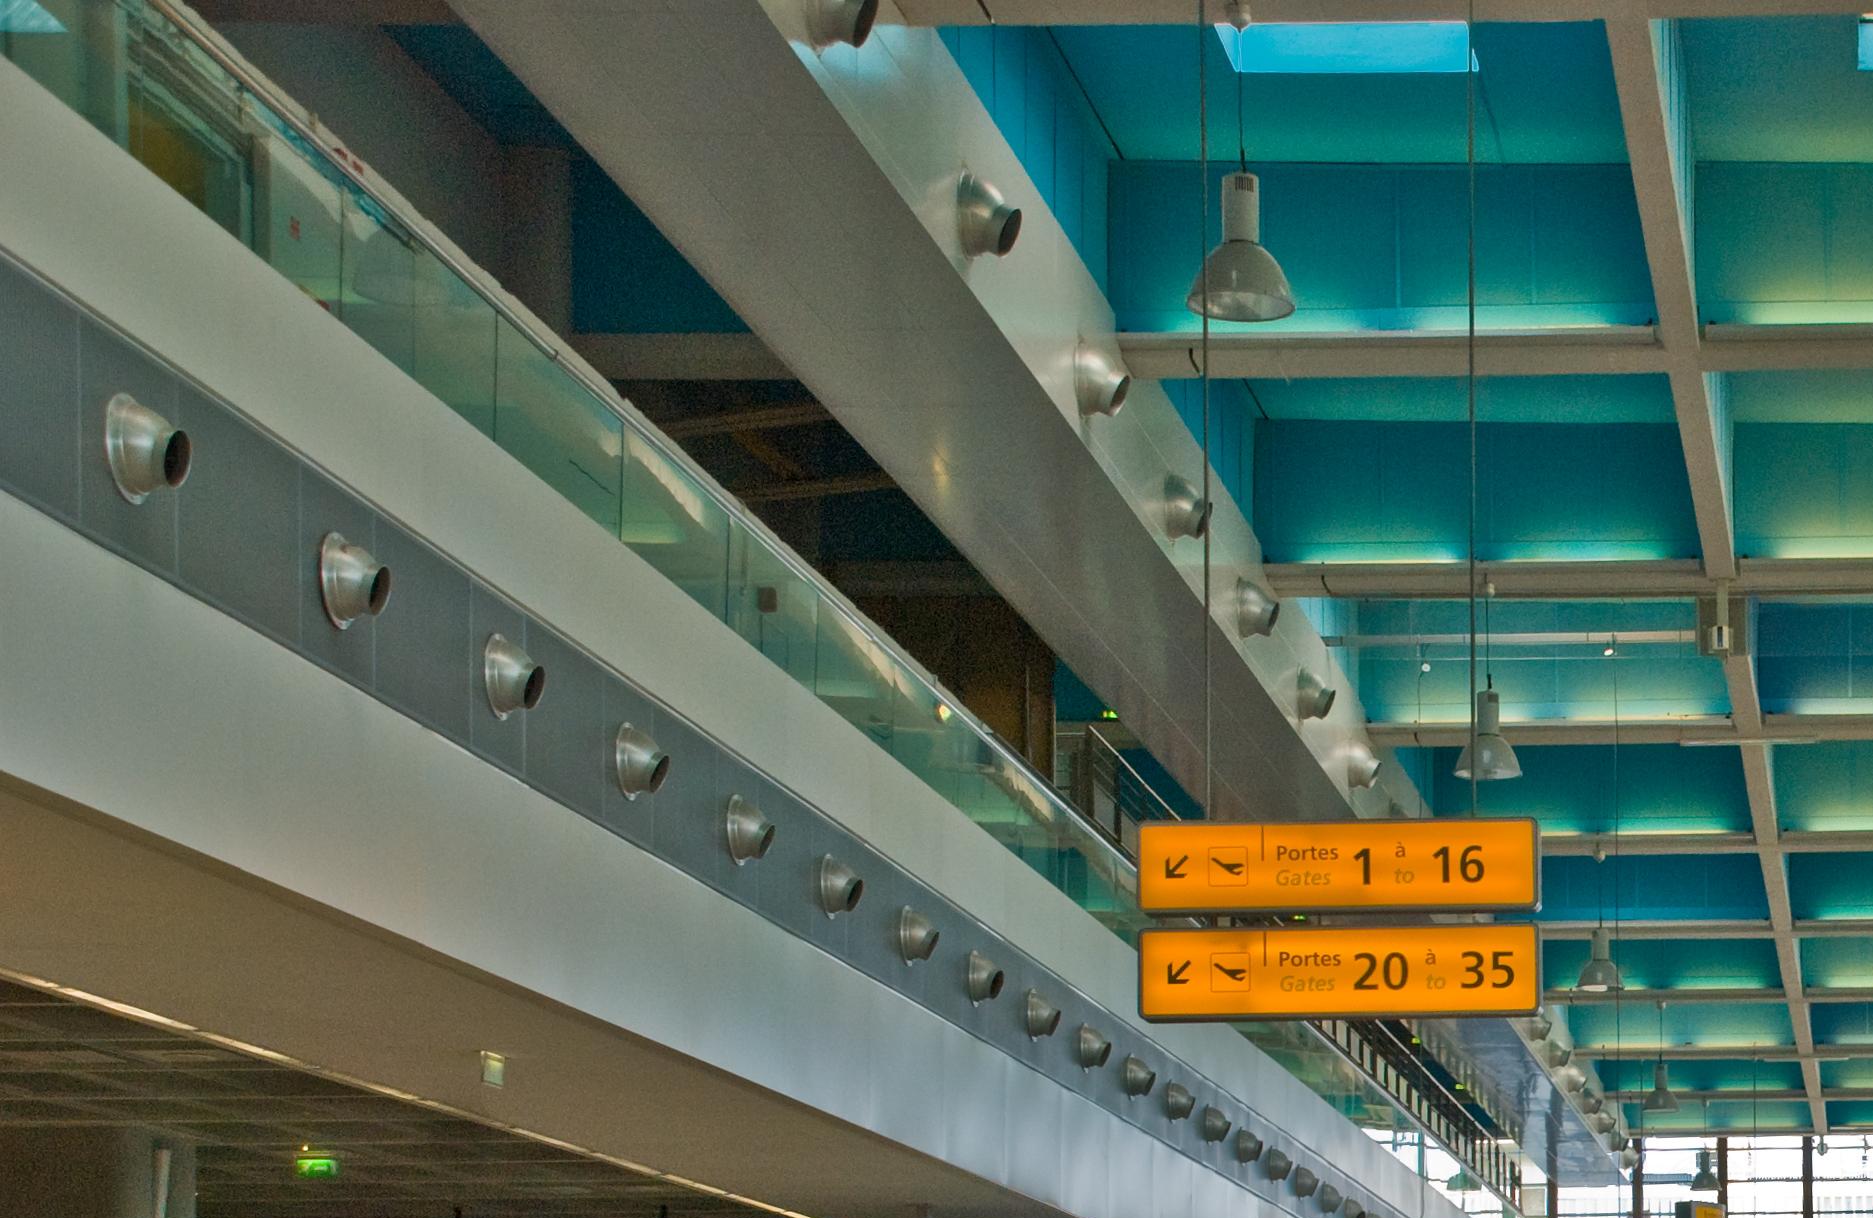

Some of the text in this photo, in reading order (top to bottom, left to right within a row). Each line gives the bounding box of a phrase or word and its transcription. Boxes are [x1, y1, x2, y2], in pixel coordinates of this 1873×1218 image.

[1275, 868, 1414, 886] Gates to
[1276, 841, 1485, 885] Portes 1 à 16
[1278, 948, 1515, 991] Portes 20 à 35
[1280, 973, 1446, 992] Gates to
